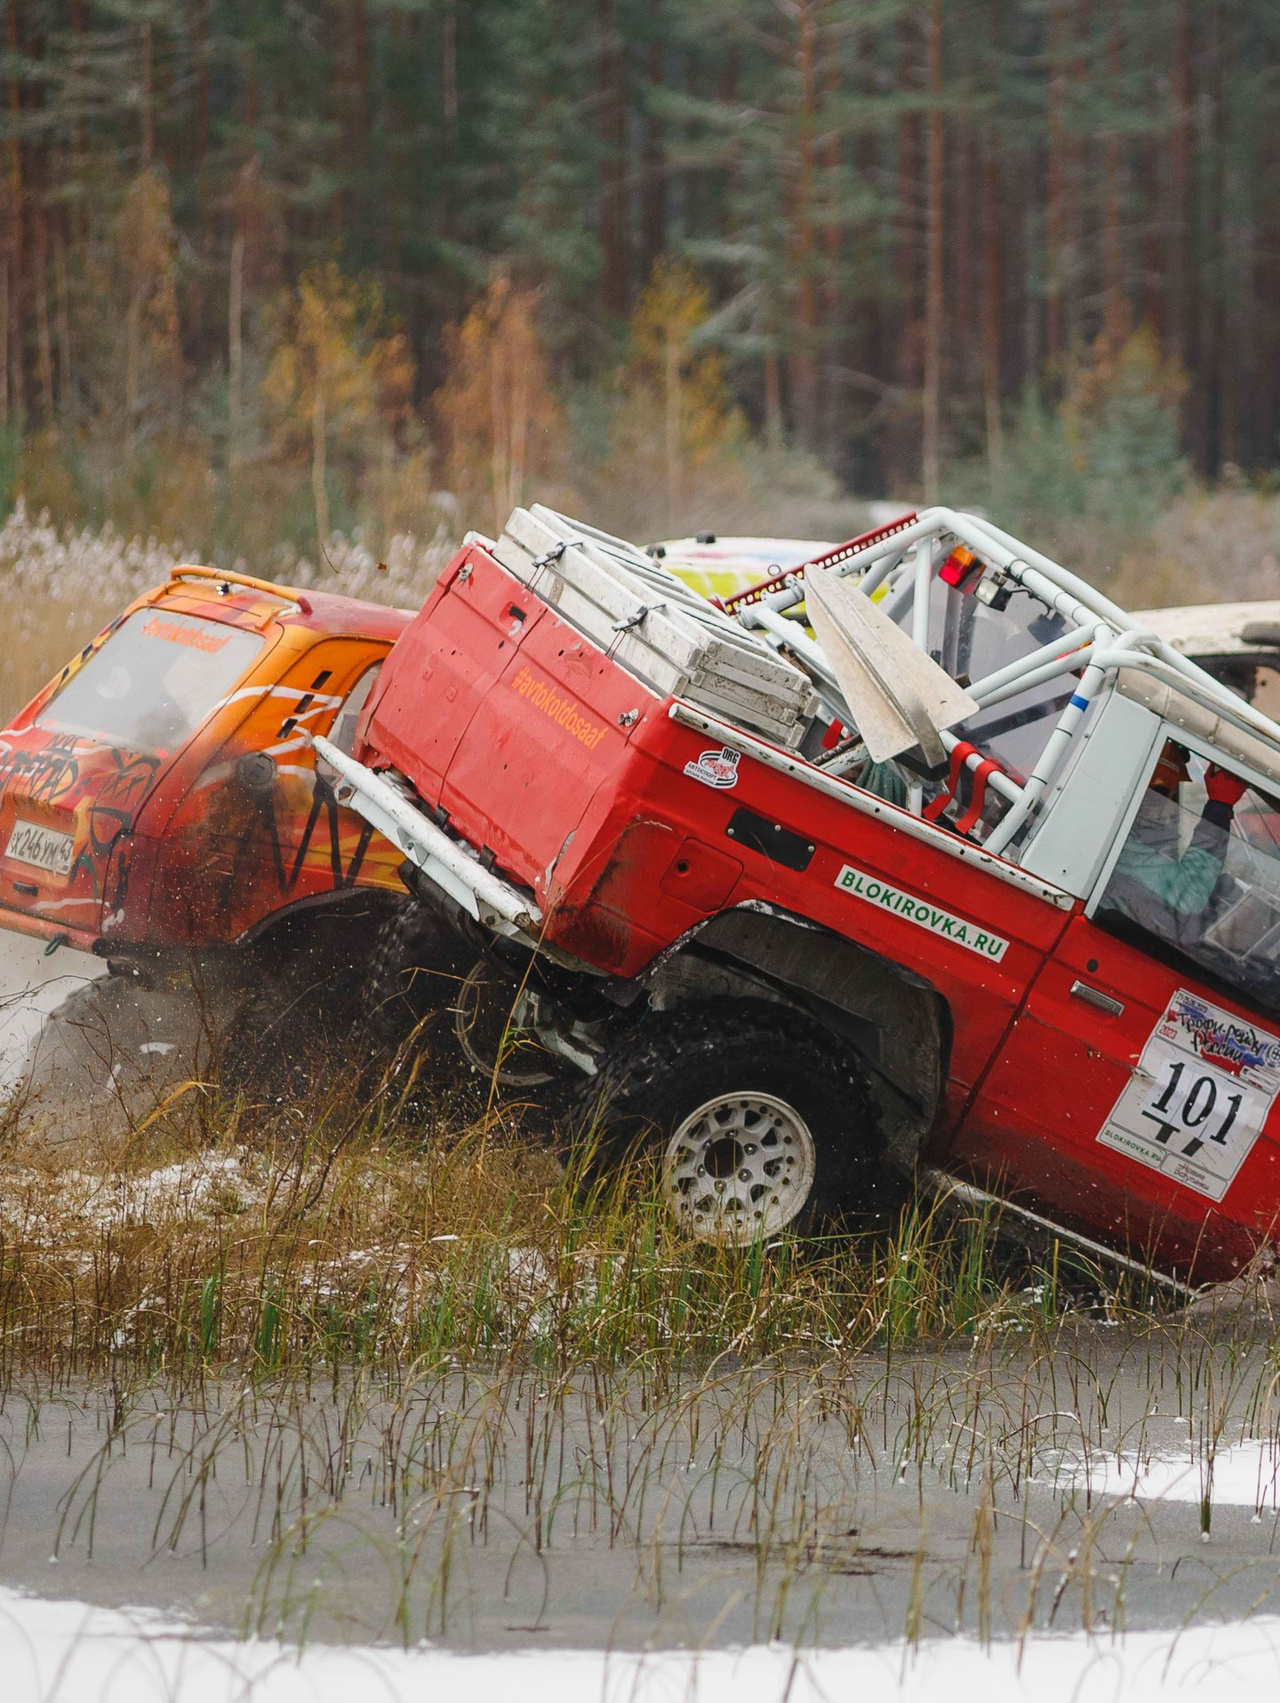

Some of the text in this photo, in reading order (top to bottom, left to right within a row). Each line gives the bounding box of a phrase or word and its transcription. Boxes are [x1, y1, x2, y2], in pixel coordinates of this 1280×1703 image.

[511, 666, 610, 750] #avtokotdosaaf
[722, 748, 739, 764] ORG
[841, 870, 1003, 956] BLOKIROVKA.RU
[1151, 1061, 1243, 1146] 101
